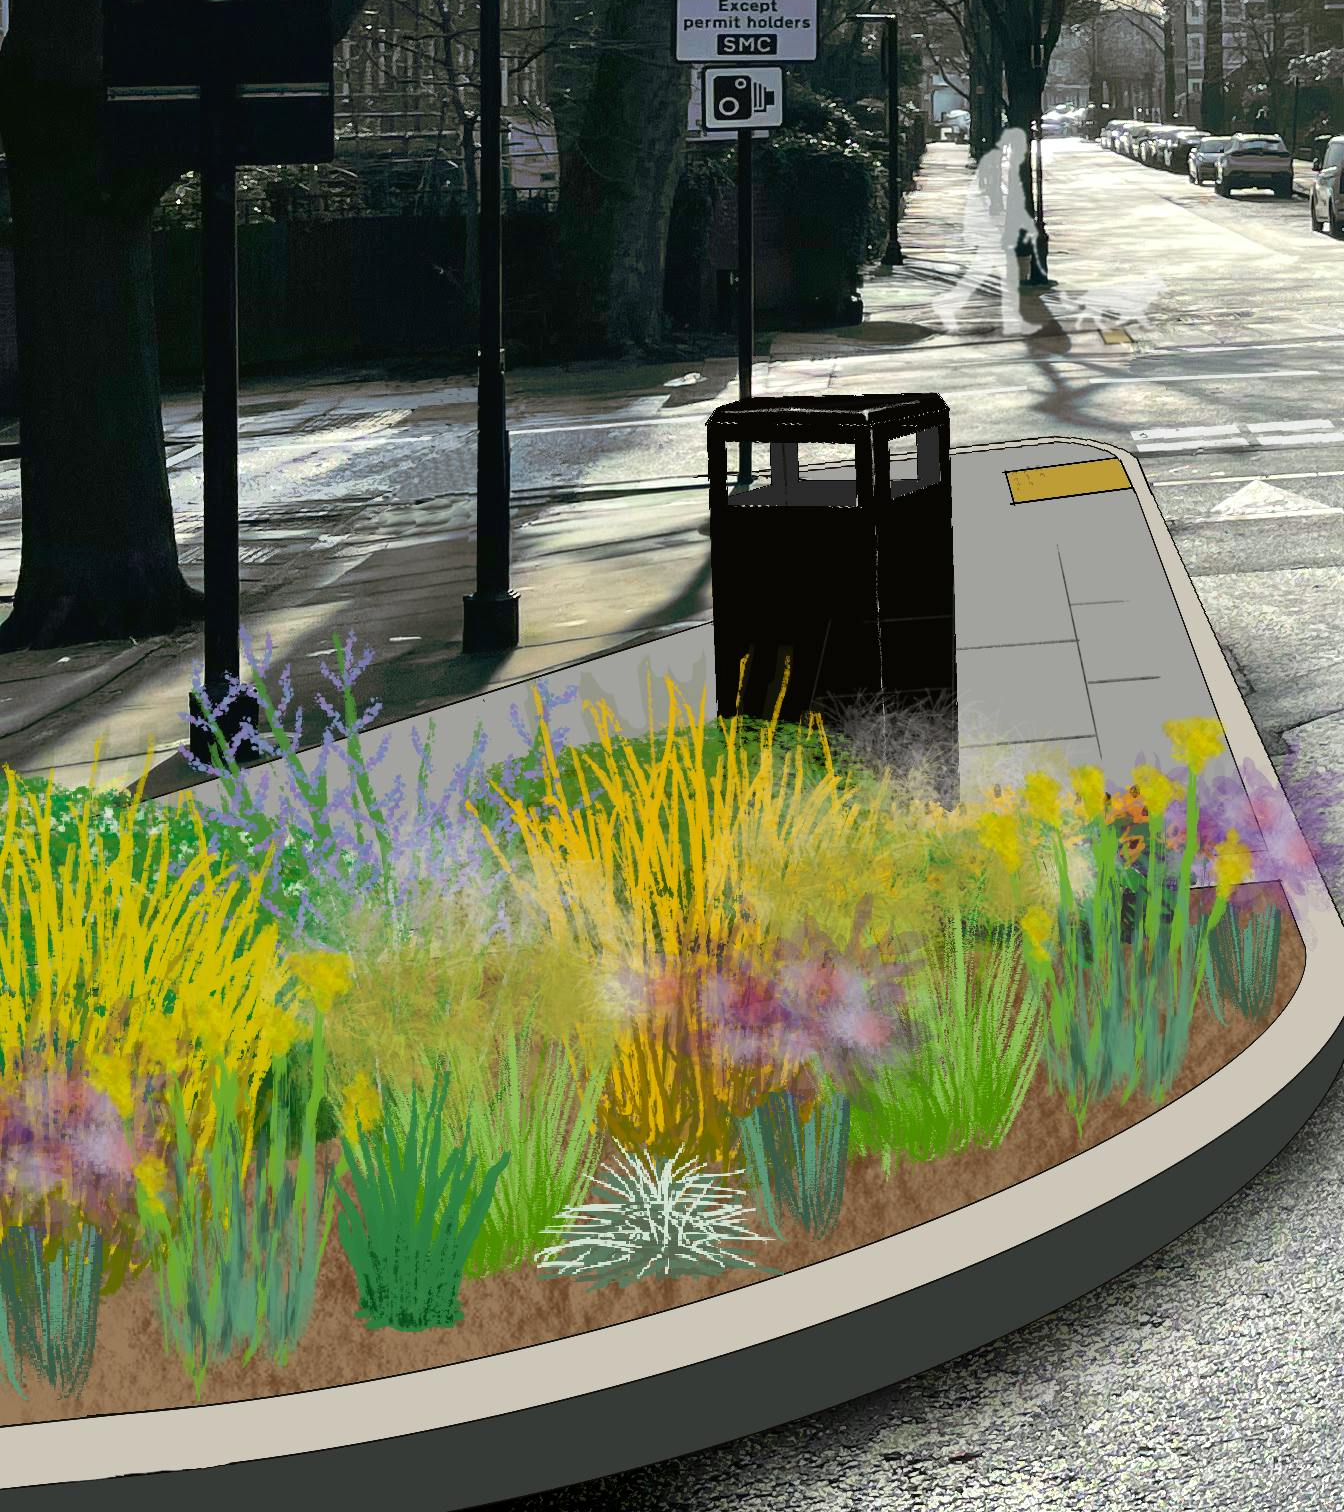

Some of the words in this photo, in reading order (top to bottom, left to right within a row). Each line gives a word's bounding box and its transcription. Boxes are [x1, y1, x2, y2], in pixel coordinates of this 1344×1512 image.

[718, 0, 778, 13] Except
[683, 16, 740, 30] permit
[747, 16, 811, 29] holders
[724, 37, 771, 52] SMC
